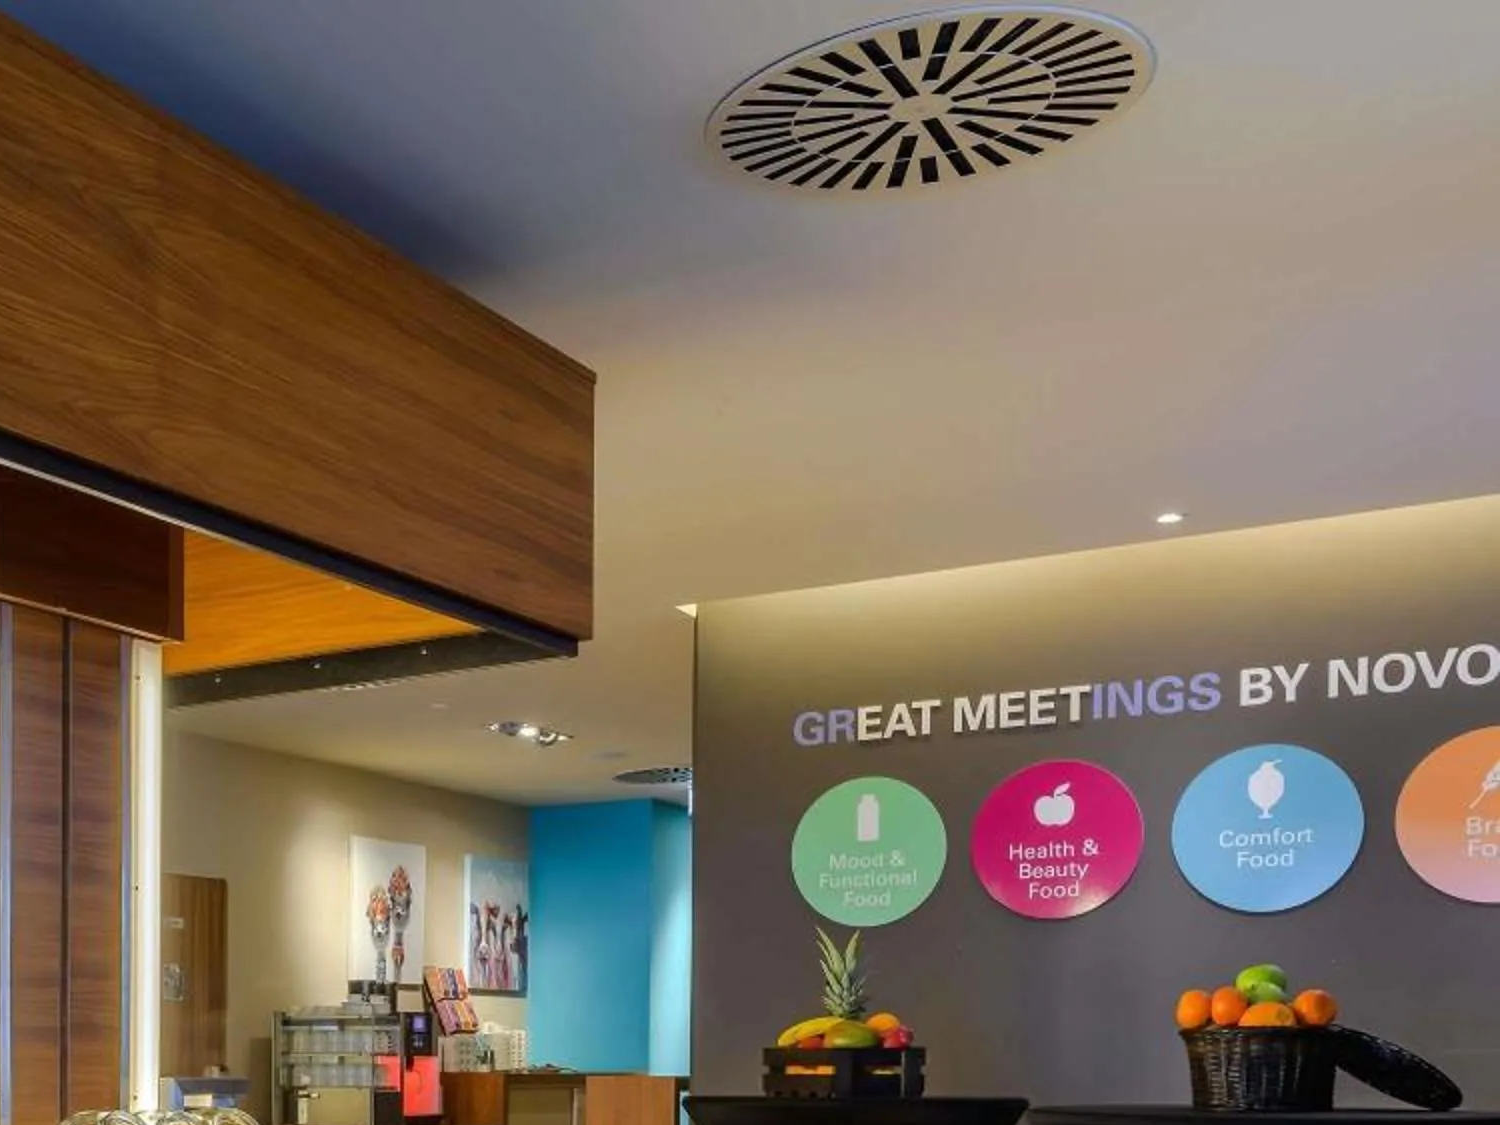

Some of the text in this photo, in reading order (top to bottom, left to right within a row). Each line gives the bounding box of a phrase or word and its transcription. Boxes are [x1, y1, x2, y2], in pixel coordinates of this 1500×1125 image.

[792, 643, 1500, 747] GREAT MEETINGS BY NOVO
[1008, 837, 1100, 861] Health &
[1218, 827, 1315, 849] Comfort
[828, 849, 906, 872] Mood &
[1236, 848, 1295, 869] Food
[818, 868, 918, 890] Functional
[1018, 861, 1091, 881] Beauty
[843, 889, 892, 908] Food
[1027, 880, 1080, 900] Food
